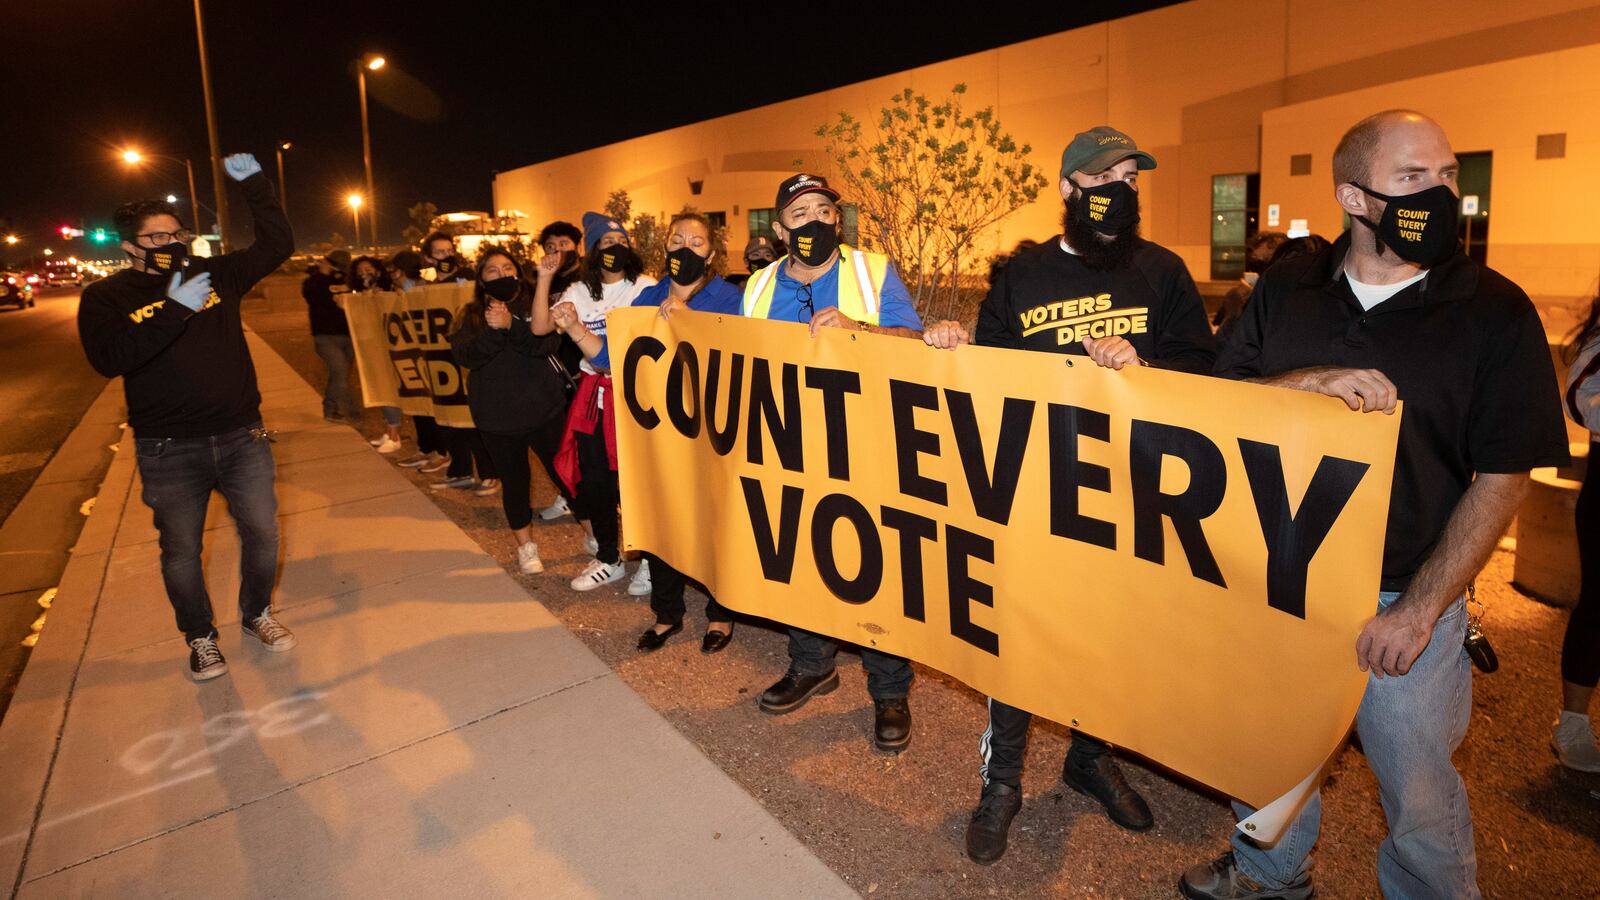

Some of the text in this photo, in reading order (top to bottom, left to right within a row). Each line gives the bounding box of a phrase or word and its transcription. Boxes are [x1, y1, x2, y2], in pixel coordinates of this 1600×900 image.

[1090, 195, 1111, 205] COUNT
[1090, 203, 1108, 214] EVERY
[1397, 208, 1430, 220] COUNT
[1398, 219, 1427, 231] EVERY
[1400, 229, 1422, 241] VOTE
[130, 299, 166, 323] VOT
[1020, 293, 1112, 329] VOTERS
[1058, 315, 1148, 345] DECIDE
[623, 335, 1371, 619] COUNT EVERY
[739, 476, 999, 657] VOTE
